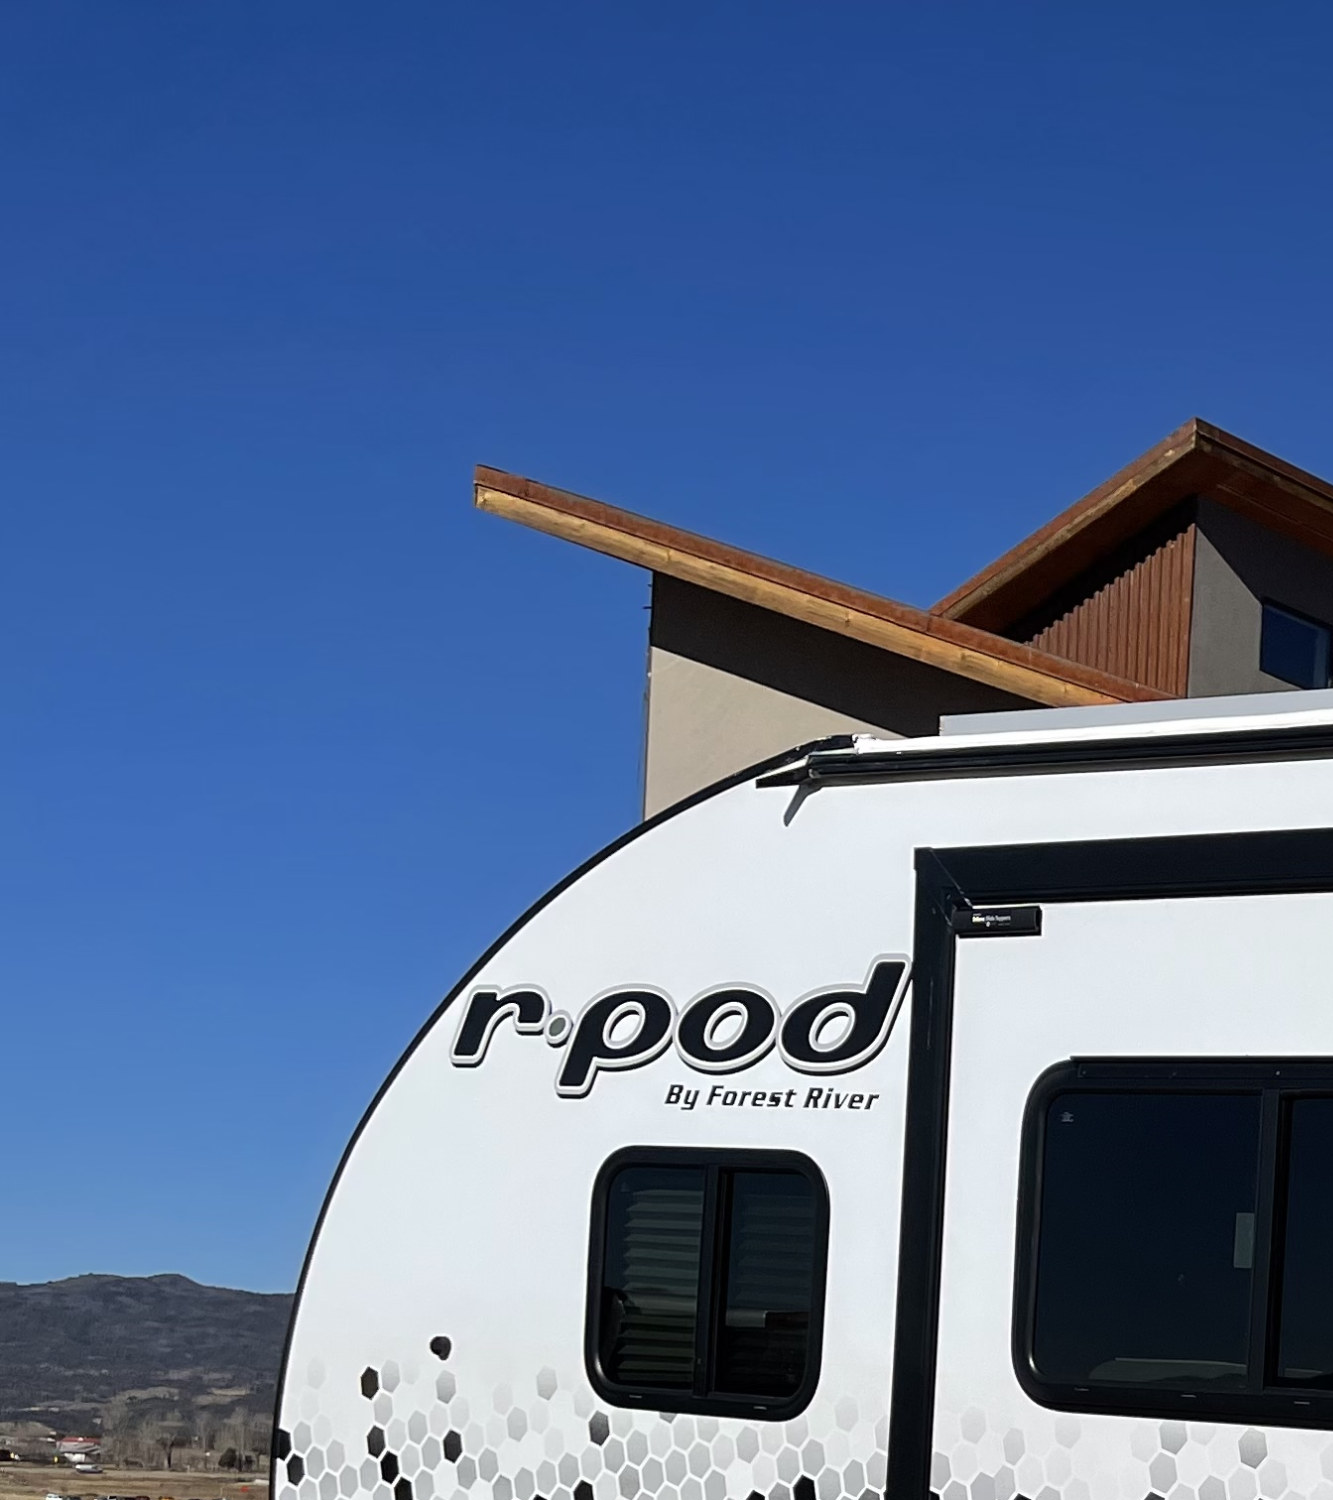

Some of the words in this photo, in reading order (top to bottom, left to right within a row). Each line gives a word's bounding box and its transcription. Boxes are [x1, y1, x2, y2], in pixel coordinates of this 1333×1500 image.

[664, 1084, 700, 1110] By
[706, 1085, 797, 1108] Forest
[803, 1087, 880, 1110] River
